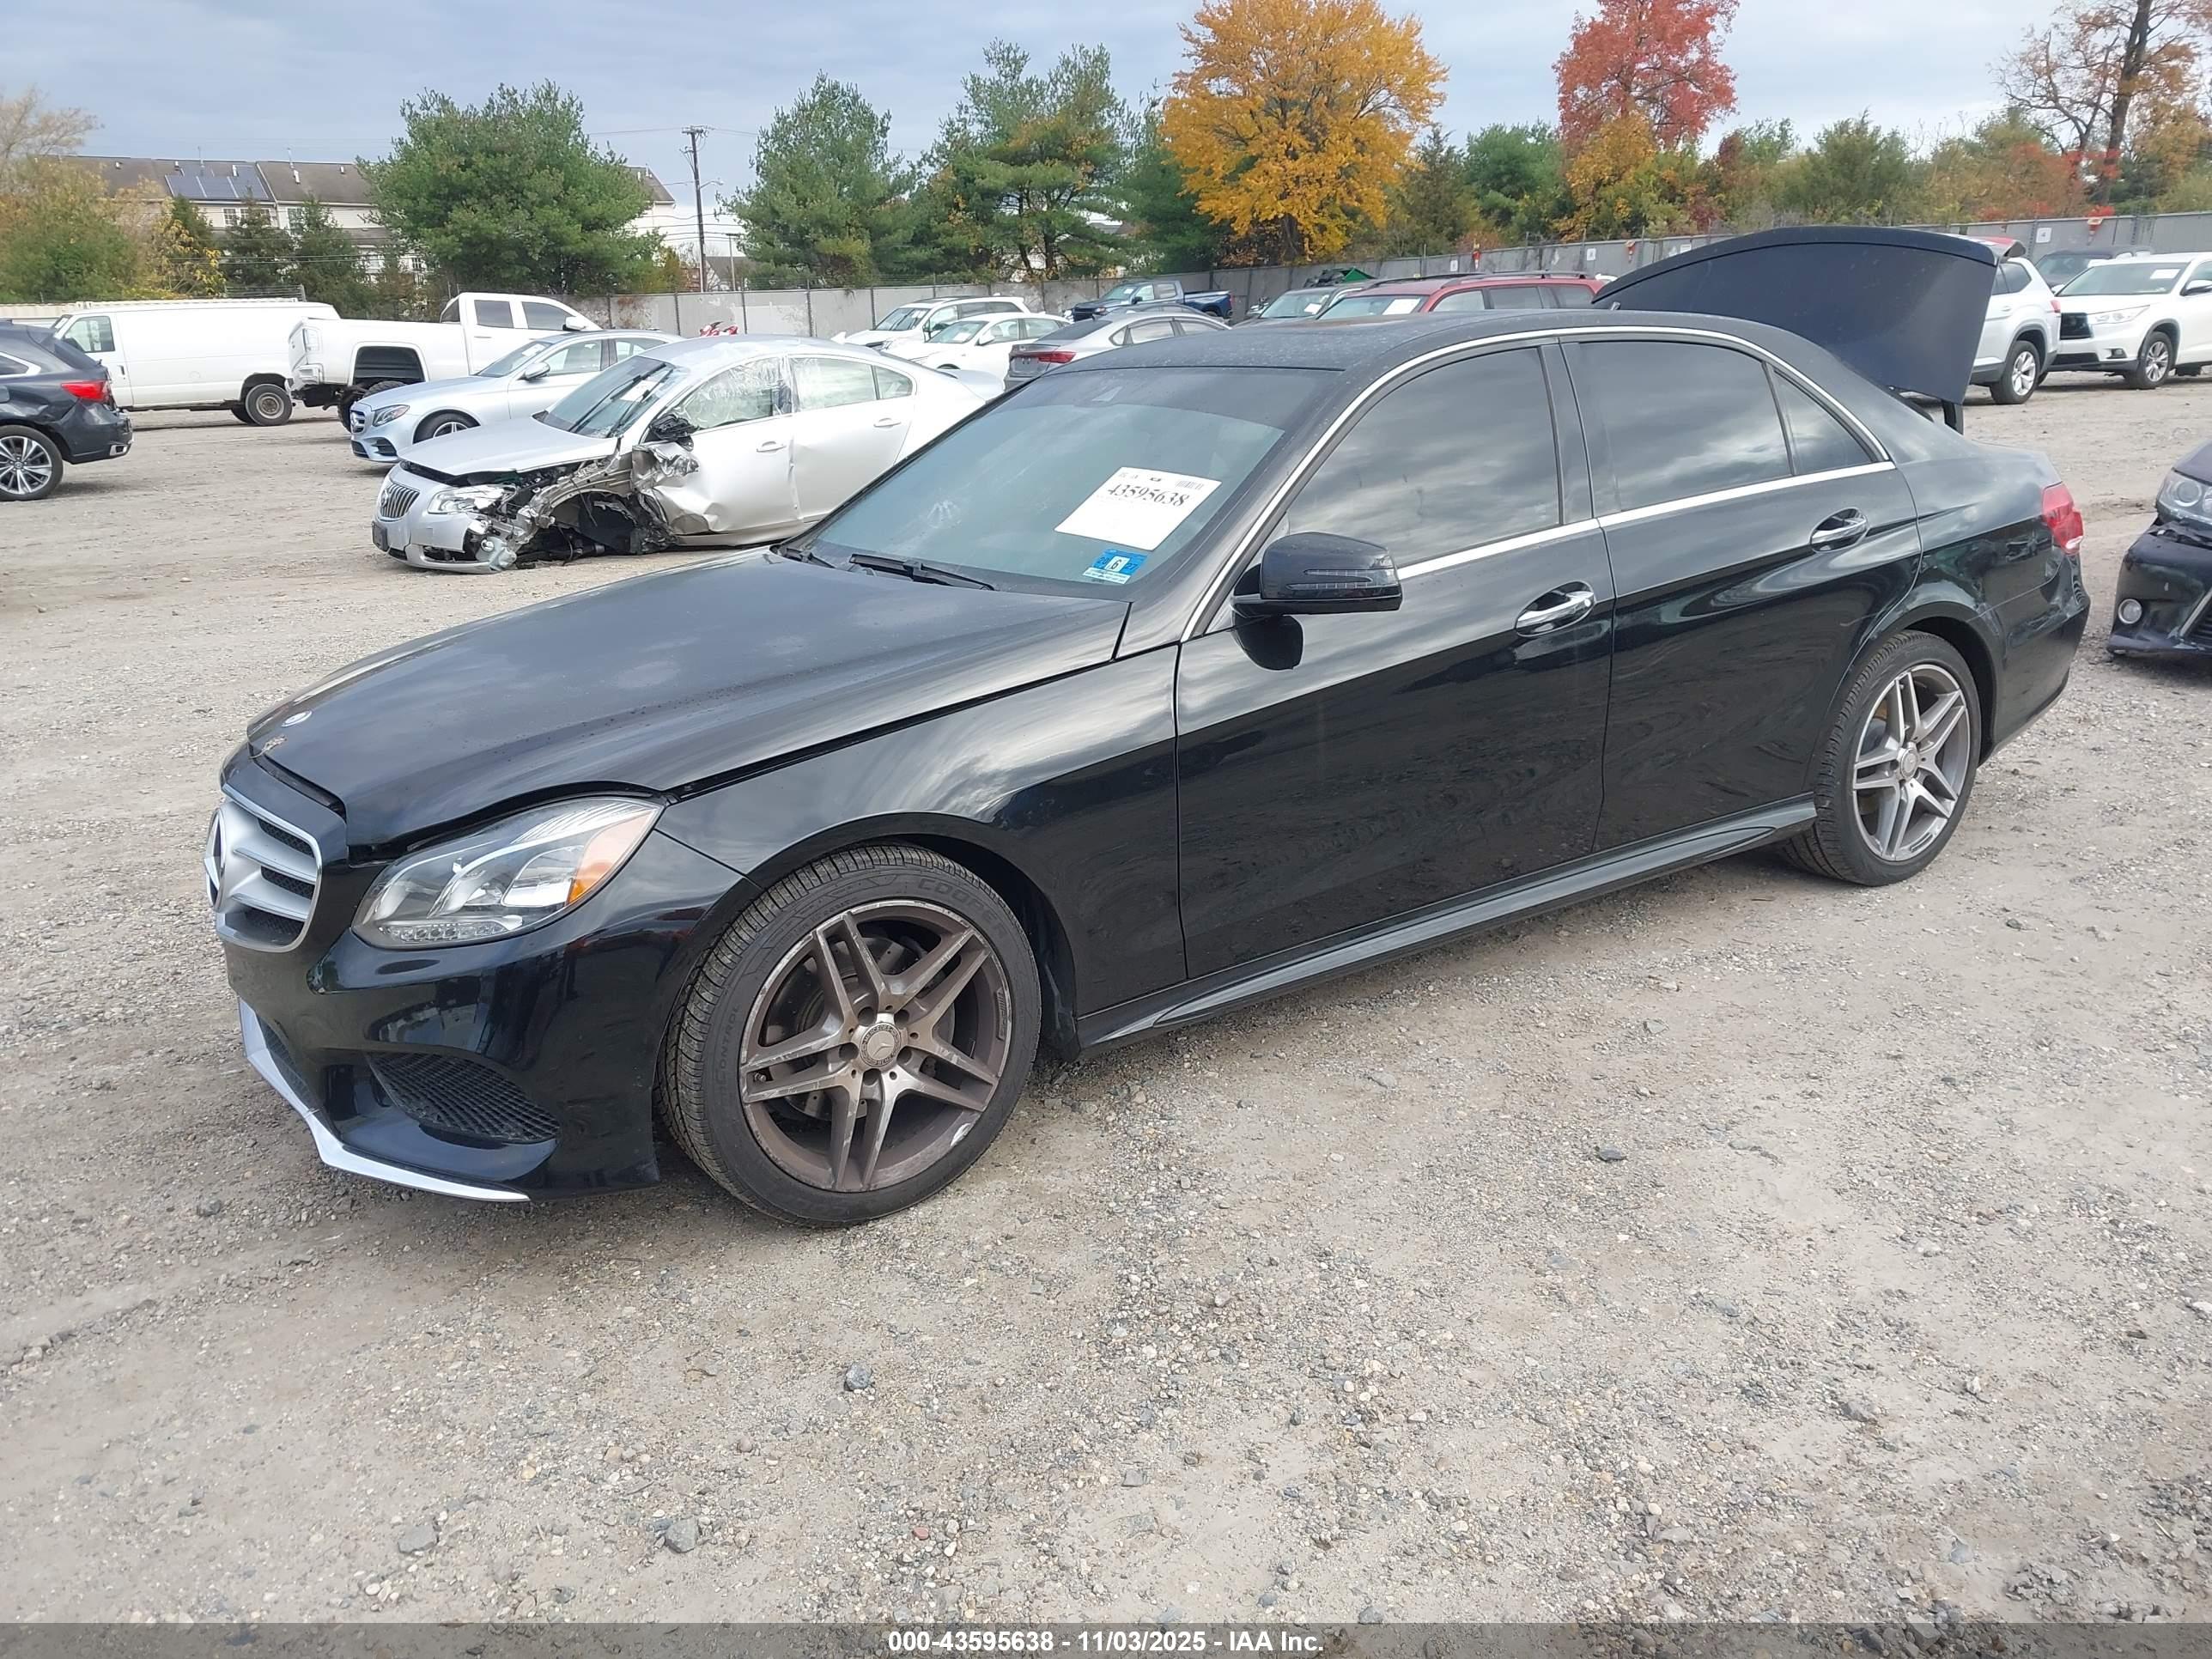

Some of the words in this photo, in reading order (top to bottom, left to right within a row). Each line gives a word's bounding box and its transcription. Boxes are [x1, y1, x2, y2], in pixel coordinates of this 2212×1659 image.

[1108, 483, 1190, 506] 43595638
[1111, 559, 1121, 569] 6
[916, 878, 1009, 941] COOPER
